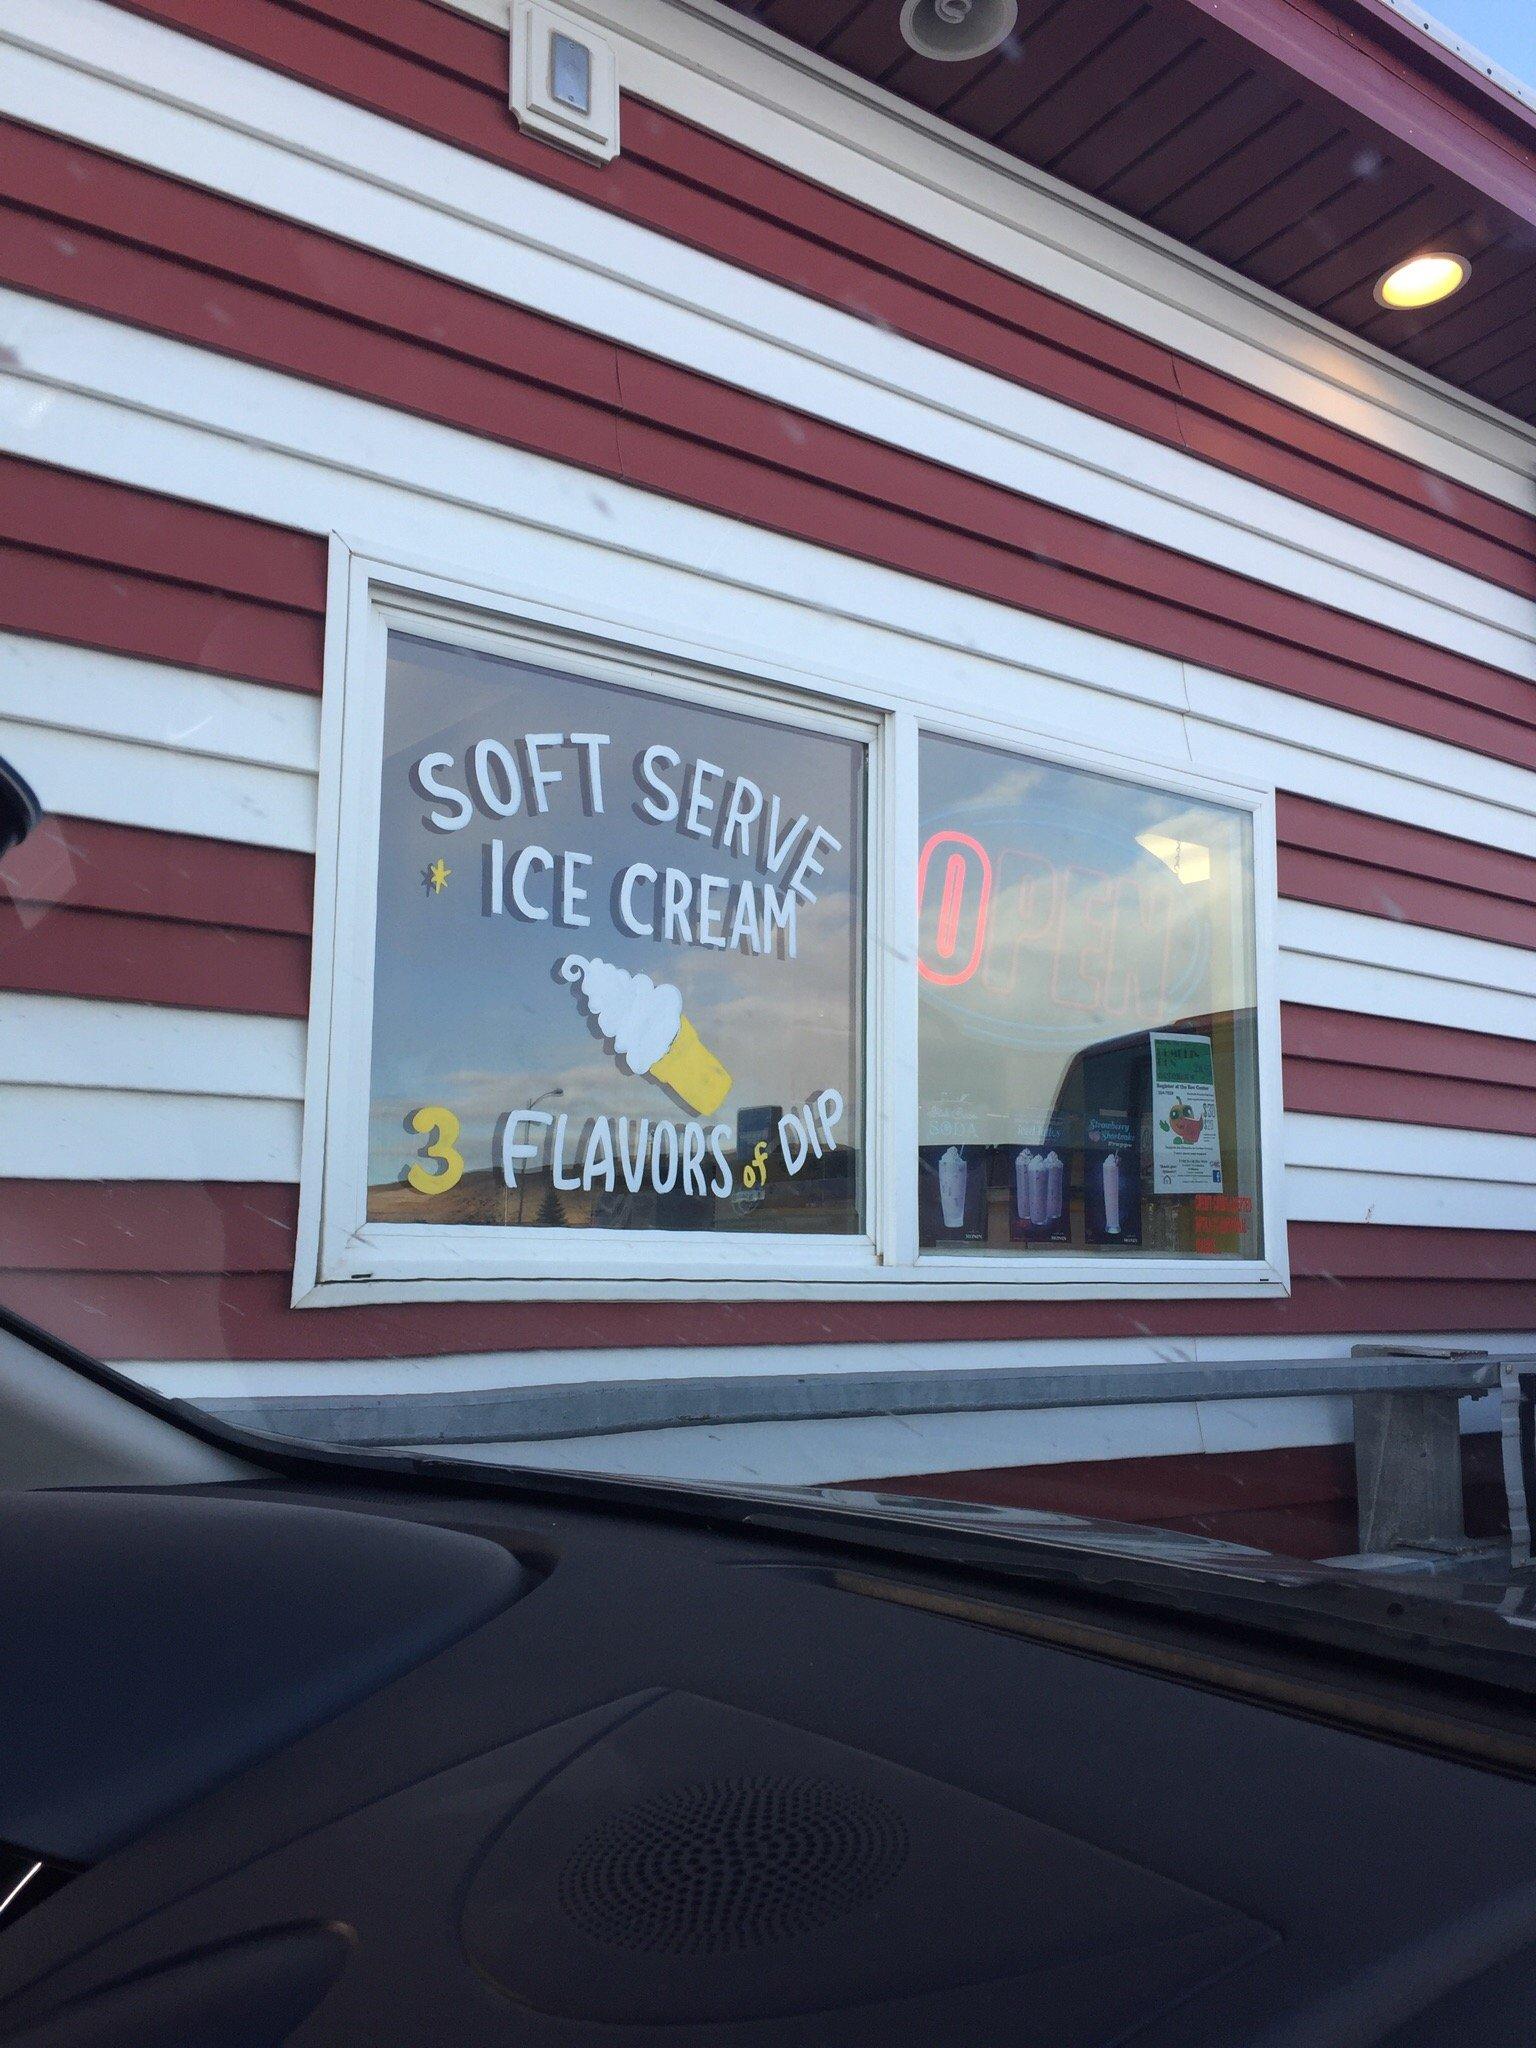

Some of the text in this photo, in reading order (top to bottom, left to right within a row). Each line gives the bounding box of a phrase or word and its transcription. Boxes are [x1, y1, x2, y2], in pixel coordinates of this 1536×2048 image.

[417, 732, 842, 904] SOFT SERVE
[491, 839, 800, 959] ICE CREAM
[406, 1087, 844, 1199] 3 FLAVORS of DIP
[1089, 1118, 1130, 1133] Strawberry
